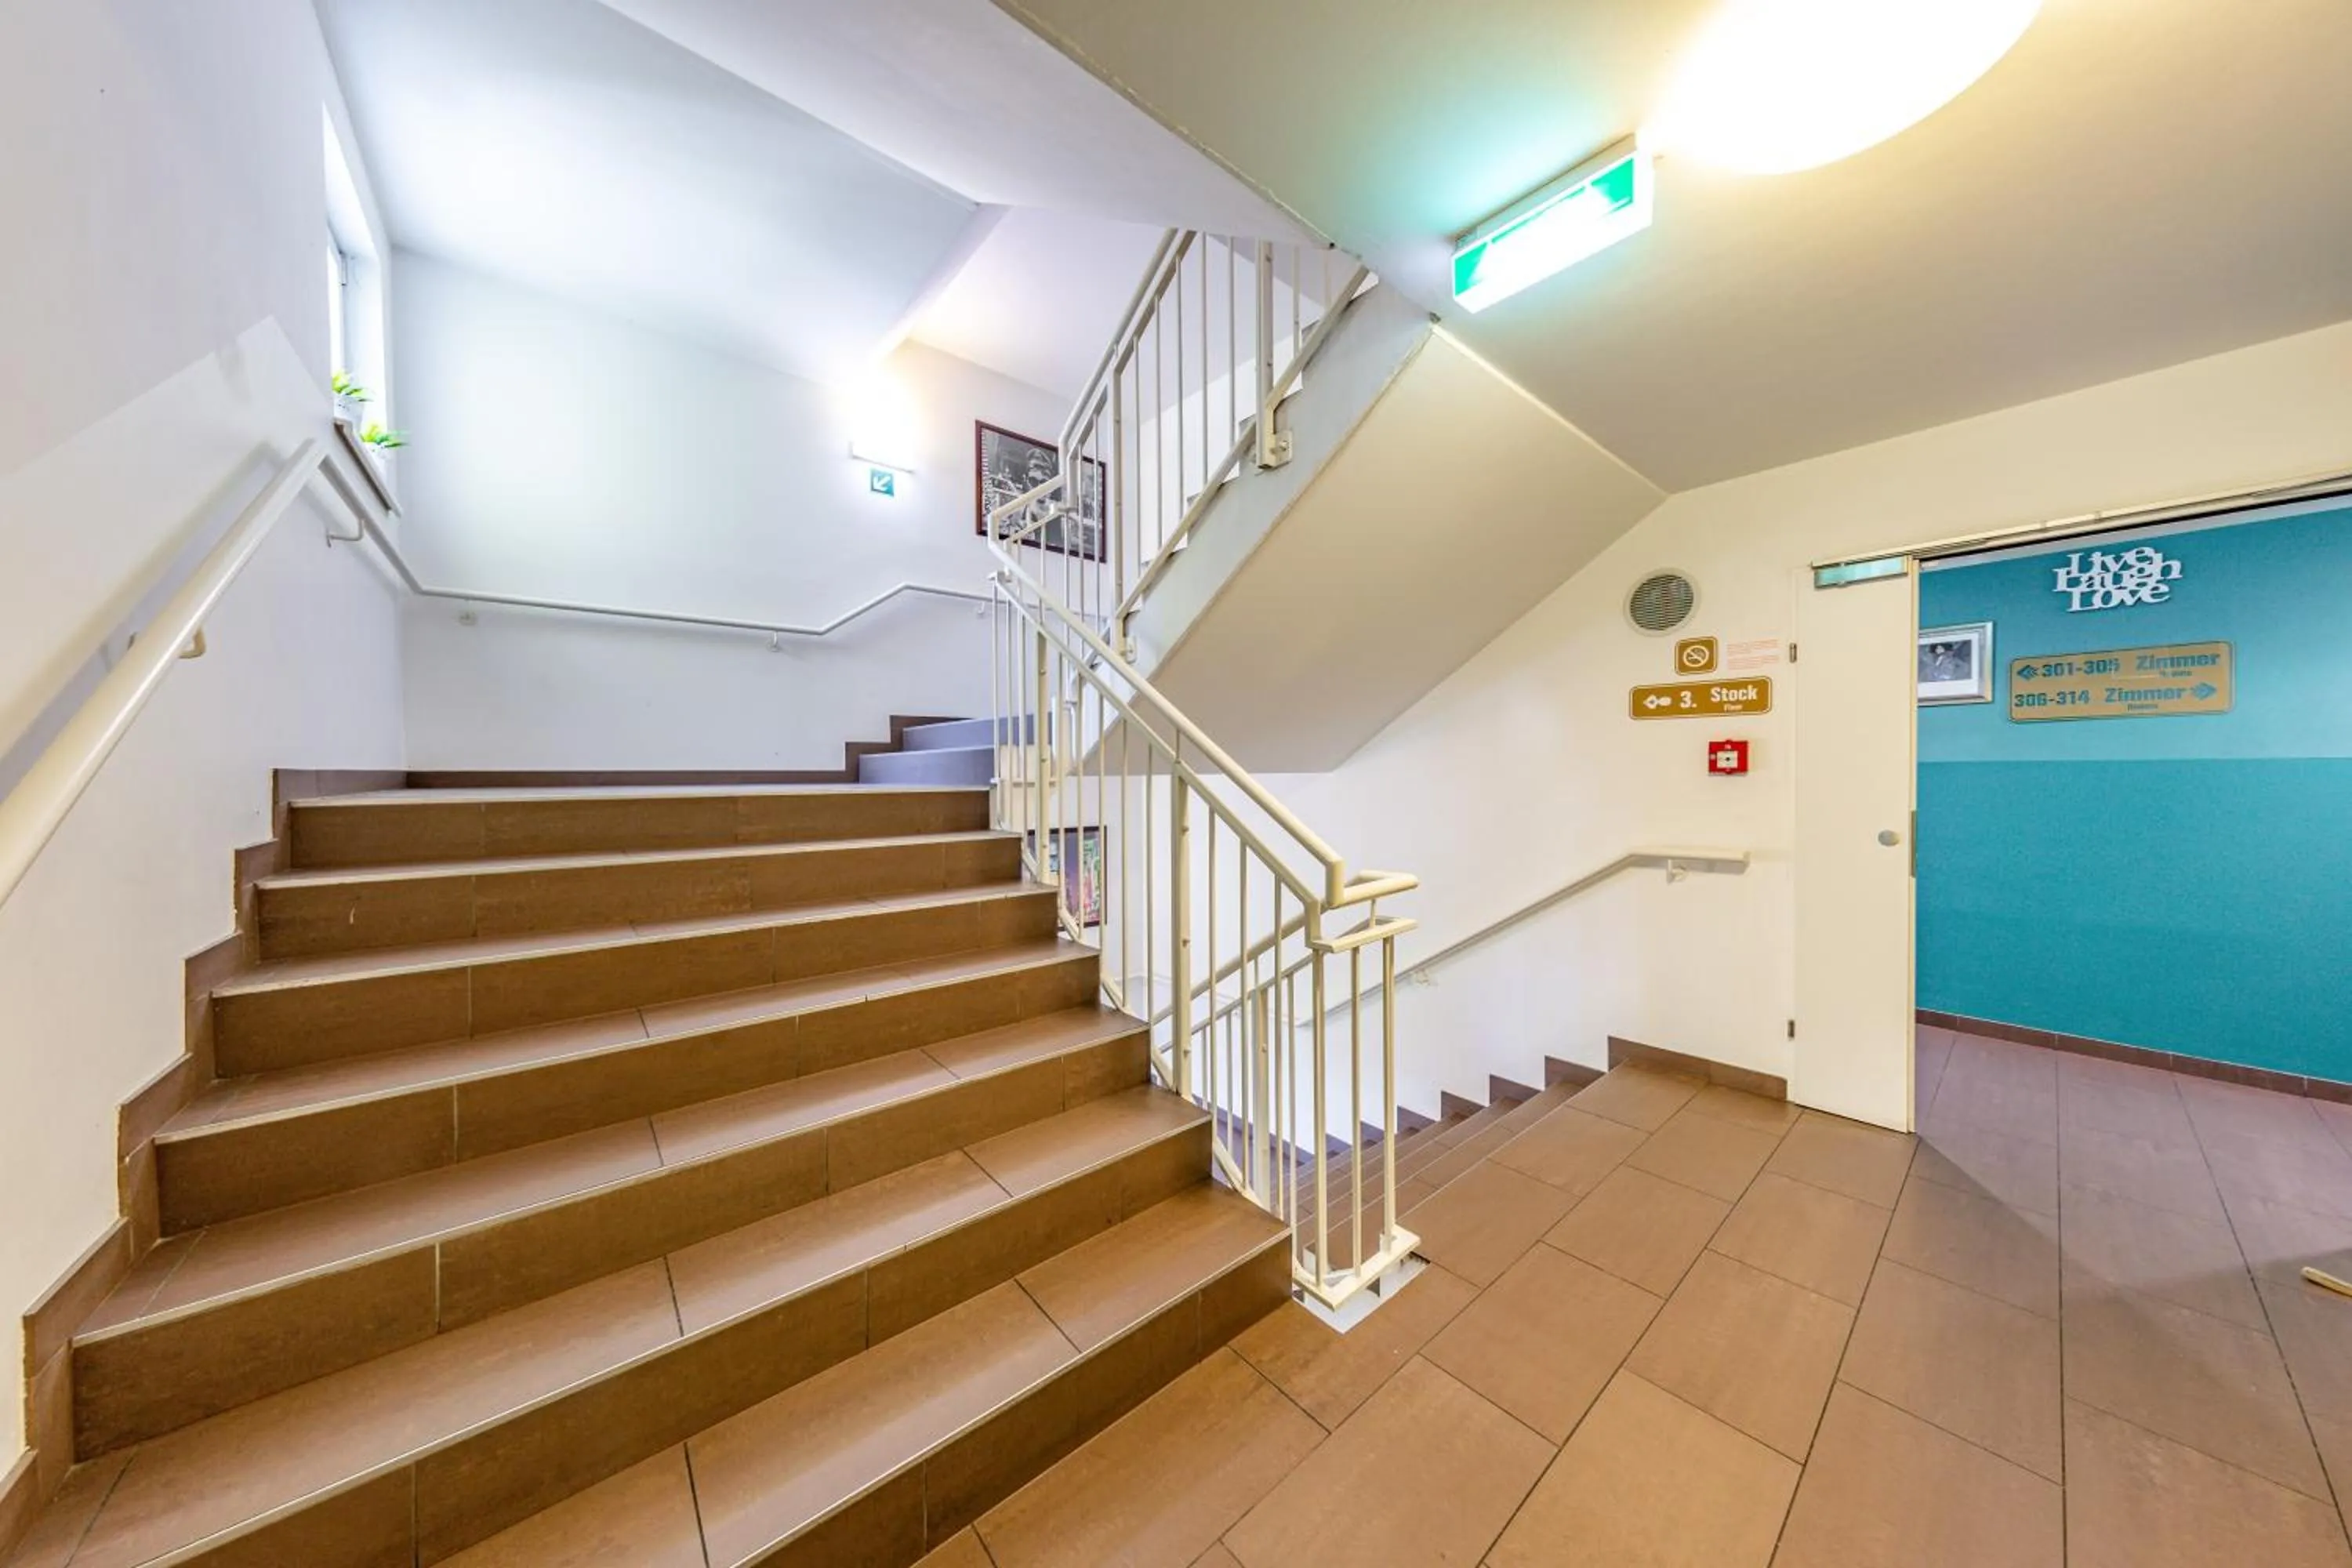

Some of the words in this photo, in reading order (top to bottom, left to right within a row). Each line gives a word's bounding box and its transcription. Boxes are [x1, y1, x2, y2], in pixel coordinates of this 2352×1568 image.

[2067, 547, 2155, 576] Live
[2067, 583, 2170, 612] Love
[2136, 653, 2220, 671] Zimmer
[1680, 690, 1697, 709] 3.
[1711, 684, 1759, 702] Stock
[2014, 690, 2089, 707] 306-314
[2105, 688, 2187, 702] Zimmer
